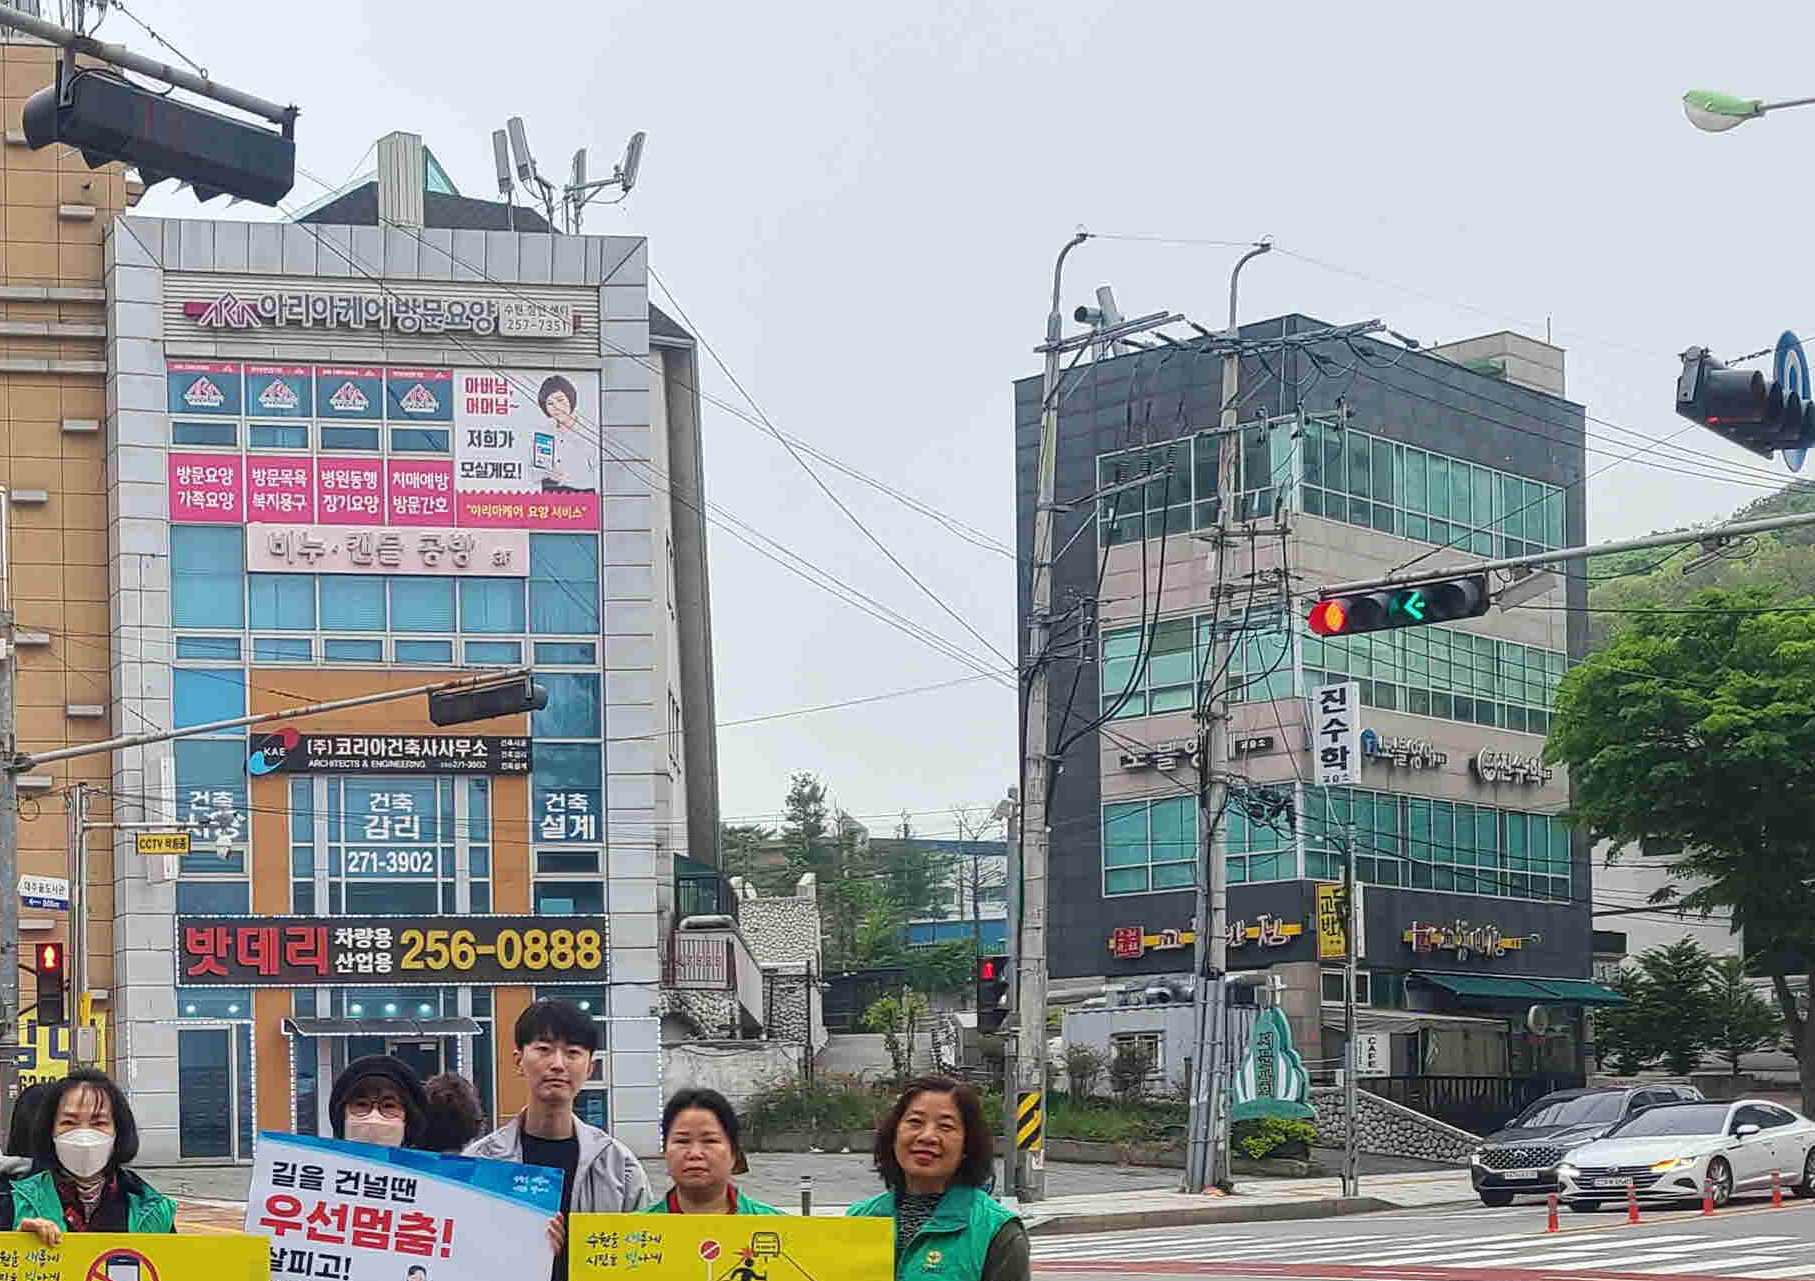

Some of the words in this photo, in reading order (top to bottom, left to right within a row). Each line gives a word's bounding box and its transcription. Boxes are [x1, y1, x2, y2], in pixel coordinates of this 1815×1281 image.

[465, 377, 513, 397] 아버님,
[467, 429, 515, 448] 저희가
[177, 466, 233, 485] 방문요양
[252, 468, 307, 488] 방문목욕
[322, 470, 377, 489] 병원동행
[393, 471, 448, 490] 치매예방
[177, 490, 233, 510] 가족요양
[253, 492, 307, 511] 복지용구
[324, 495, 378, 513] 장기요양
[394, 495, 448, 514] 방문간호
[528, 504, 549, 519] 요양
[418, 532, 475, 568] 공방
[1320, 687, 1350, 771] 진수학
[308, 759, 360, 769] ARCHITECTS
[362, 759, 369, 769] &
[370, 759, 426, 770] ENGINEERING
[369, 793, 414, 813] 건축
[545, 793, 589, 813] 건축
[363, 814, 420, 840] 감리
[540, 813, 596, 841] 설계
[139, 838, 163, 851] CCTV
[348, 850, 433, 874] 271-3902
[334, 928, 393, 950] 차량용
[400, 928, 602, 970] 256-0888
[186, 926, 329, 977] 밧데리
[335, 952, 393, 974] 산업용
[271, 1160, 324, 1192] 길을
[335, 1168, 418, 1204] 건널땐
[259, 1194, 455, 1258] 우선멈춤!
[585, 1231, 618, 1249] 수원을
[25, 1249, 61, 1268] 새롭게
[585, 1253, 618, 1267] 시민을
